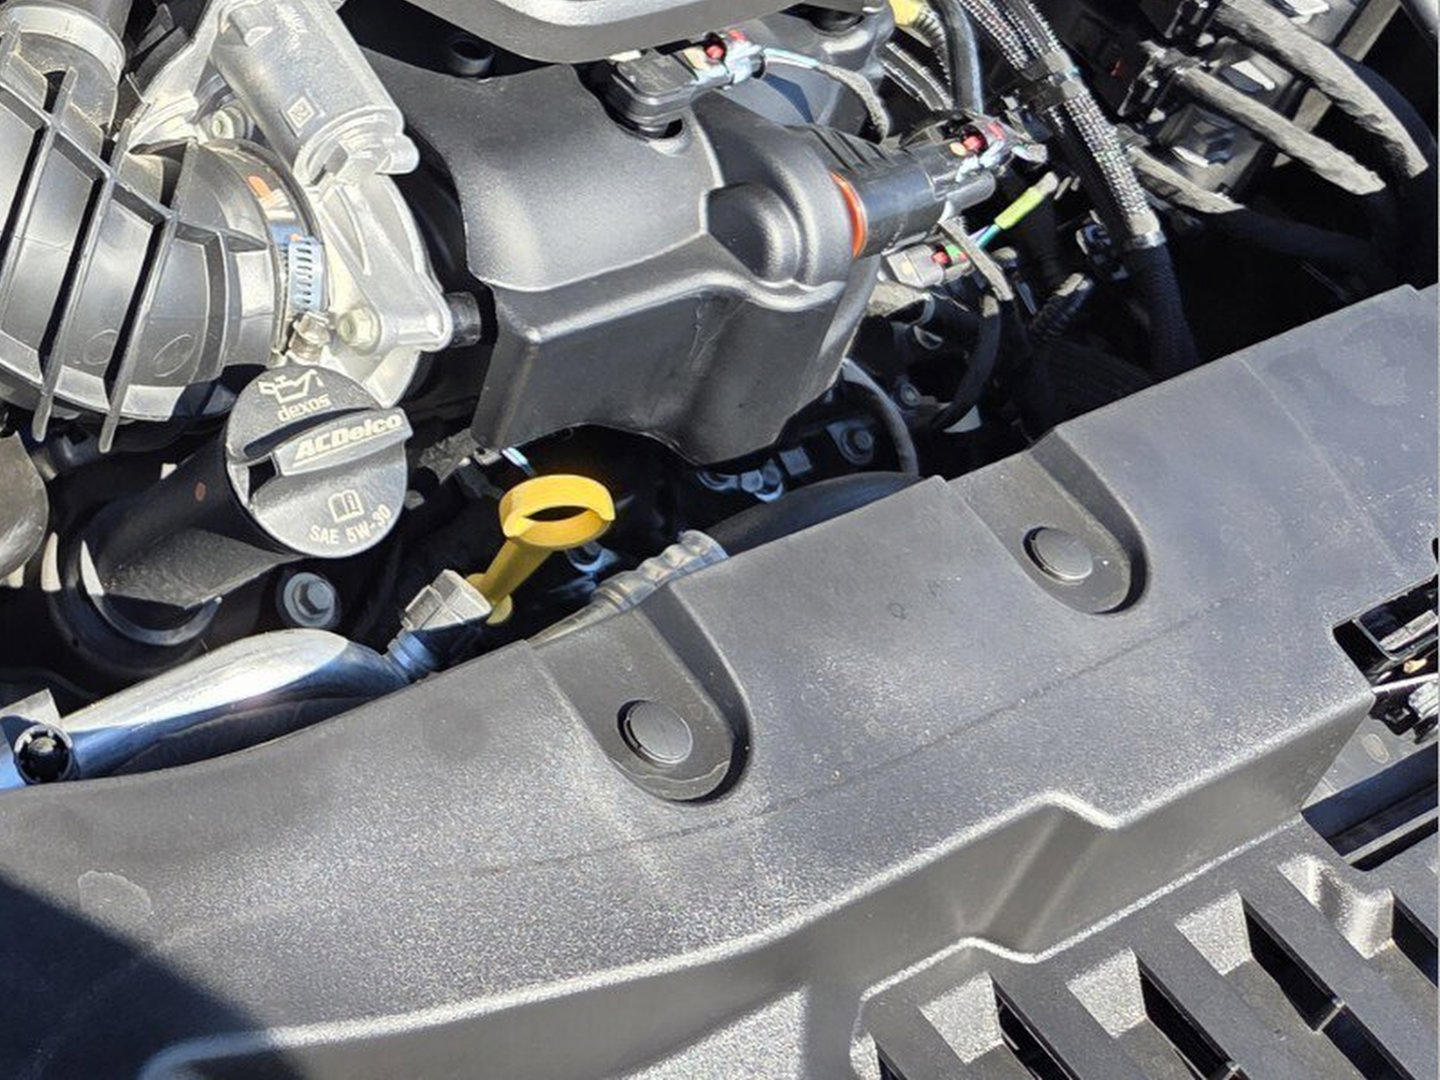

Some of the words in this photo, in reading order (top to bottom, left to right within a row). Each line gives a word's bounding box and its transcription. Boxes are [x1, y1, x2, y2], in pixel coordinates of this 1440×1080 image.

[277, 393, 332, 422] dexos
[293, 414, 403, 462] ACDelco
[308, 524, 340, 545] SAE
[345, 504, 392, 544] 5W-30
